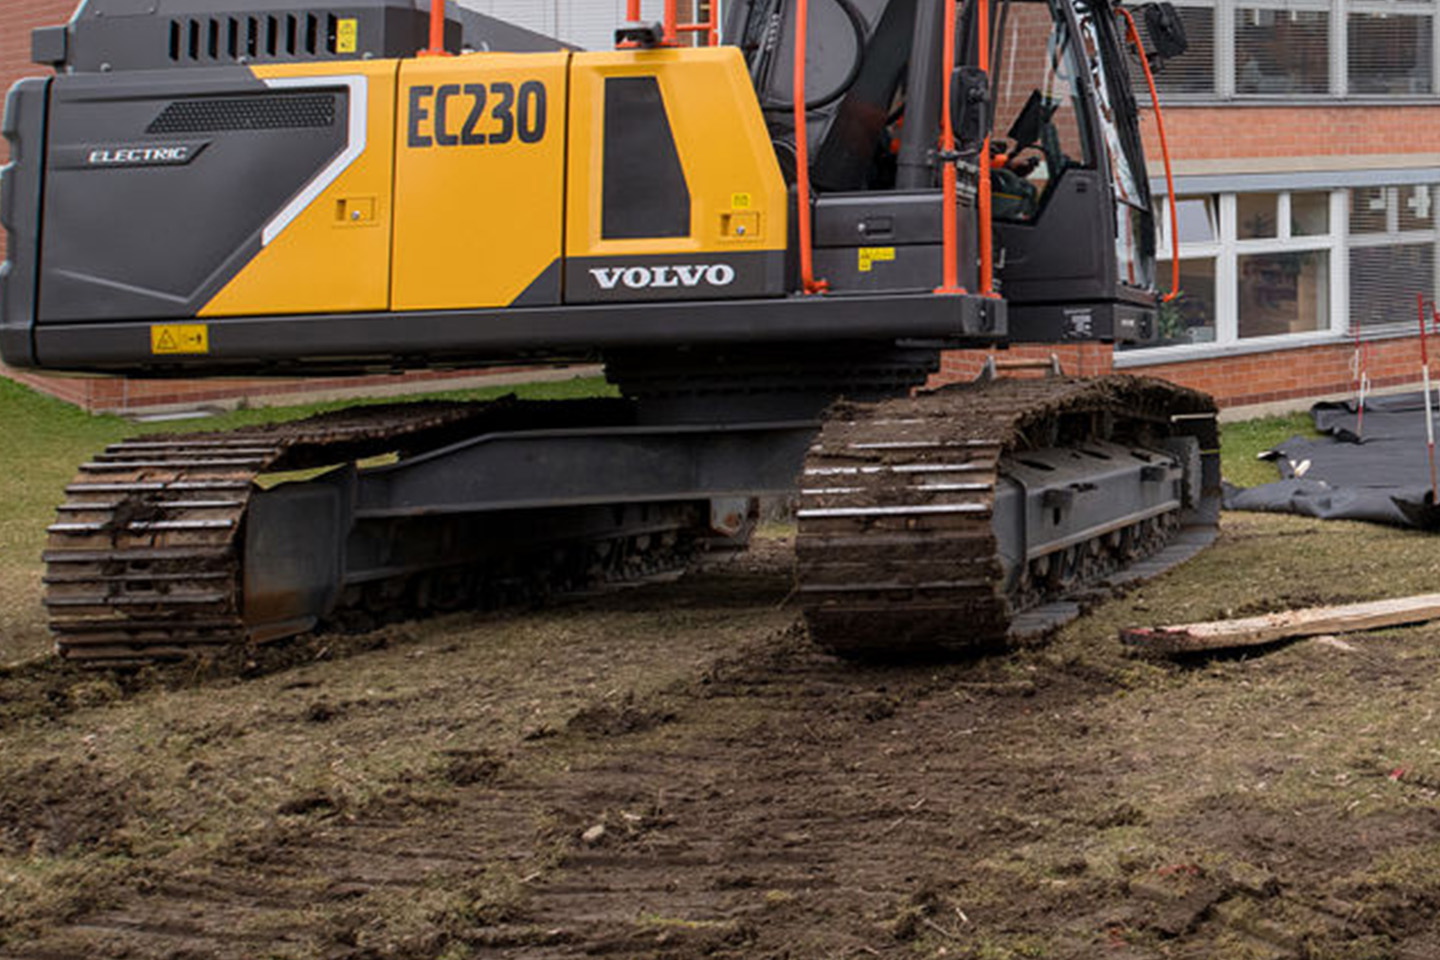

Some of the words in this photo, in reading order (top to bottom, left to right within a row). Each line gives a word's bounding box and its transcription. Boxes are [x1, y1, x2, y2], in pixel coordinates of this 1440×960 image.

[407, 80, 547, 148] EC230
[89, 147, 188, 162] ELECTRIC
[589, 264, 735, 289] VOLVO
